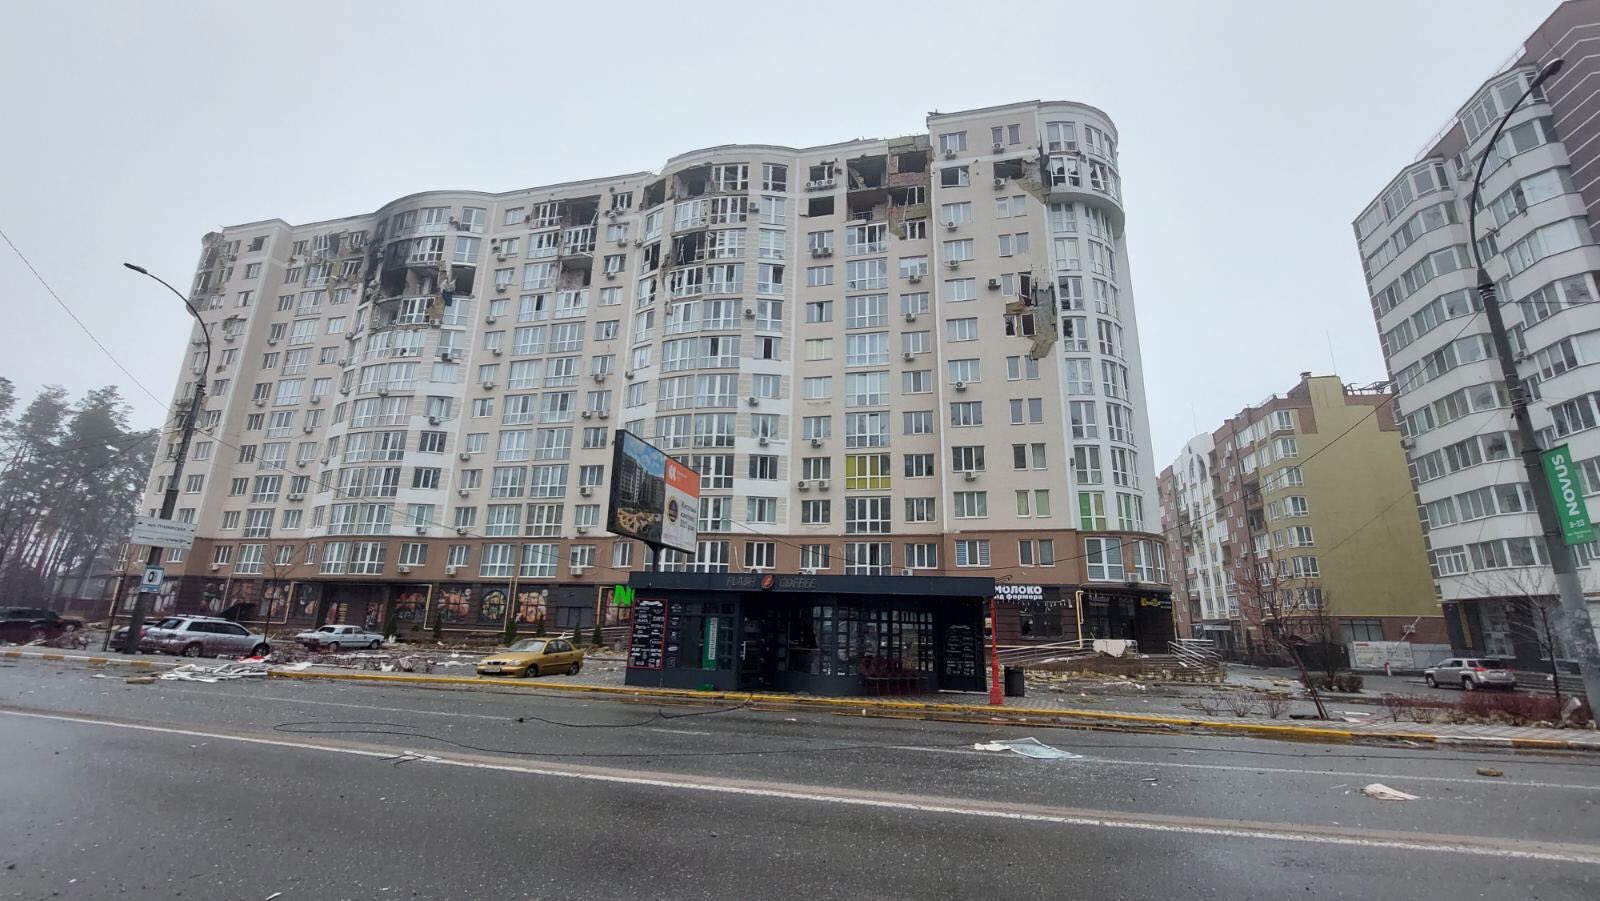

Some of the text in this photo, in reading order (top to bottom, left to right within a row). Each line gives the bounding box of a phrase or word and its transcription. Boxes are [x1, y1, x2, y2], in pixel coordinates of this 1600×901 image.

[1552, 454, 1580, 516] NOVUS
[779, 577, 817, 588] COFFEE
[994, 585, 1043, 595] МОЛОКО
